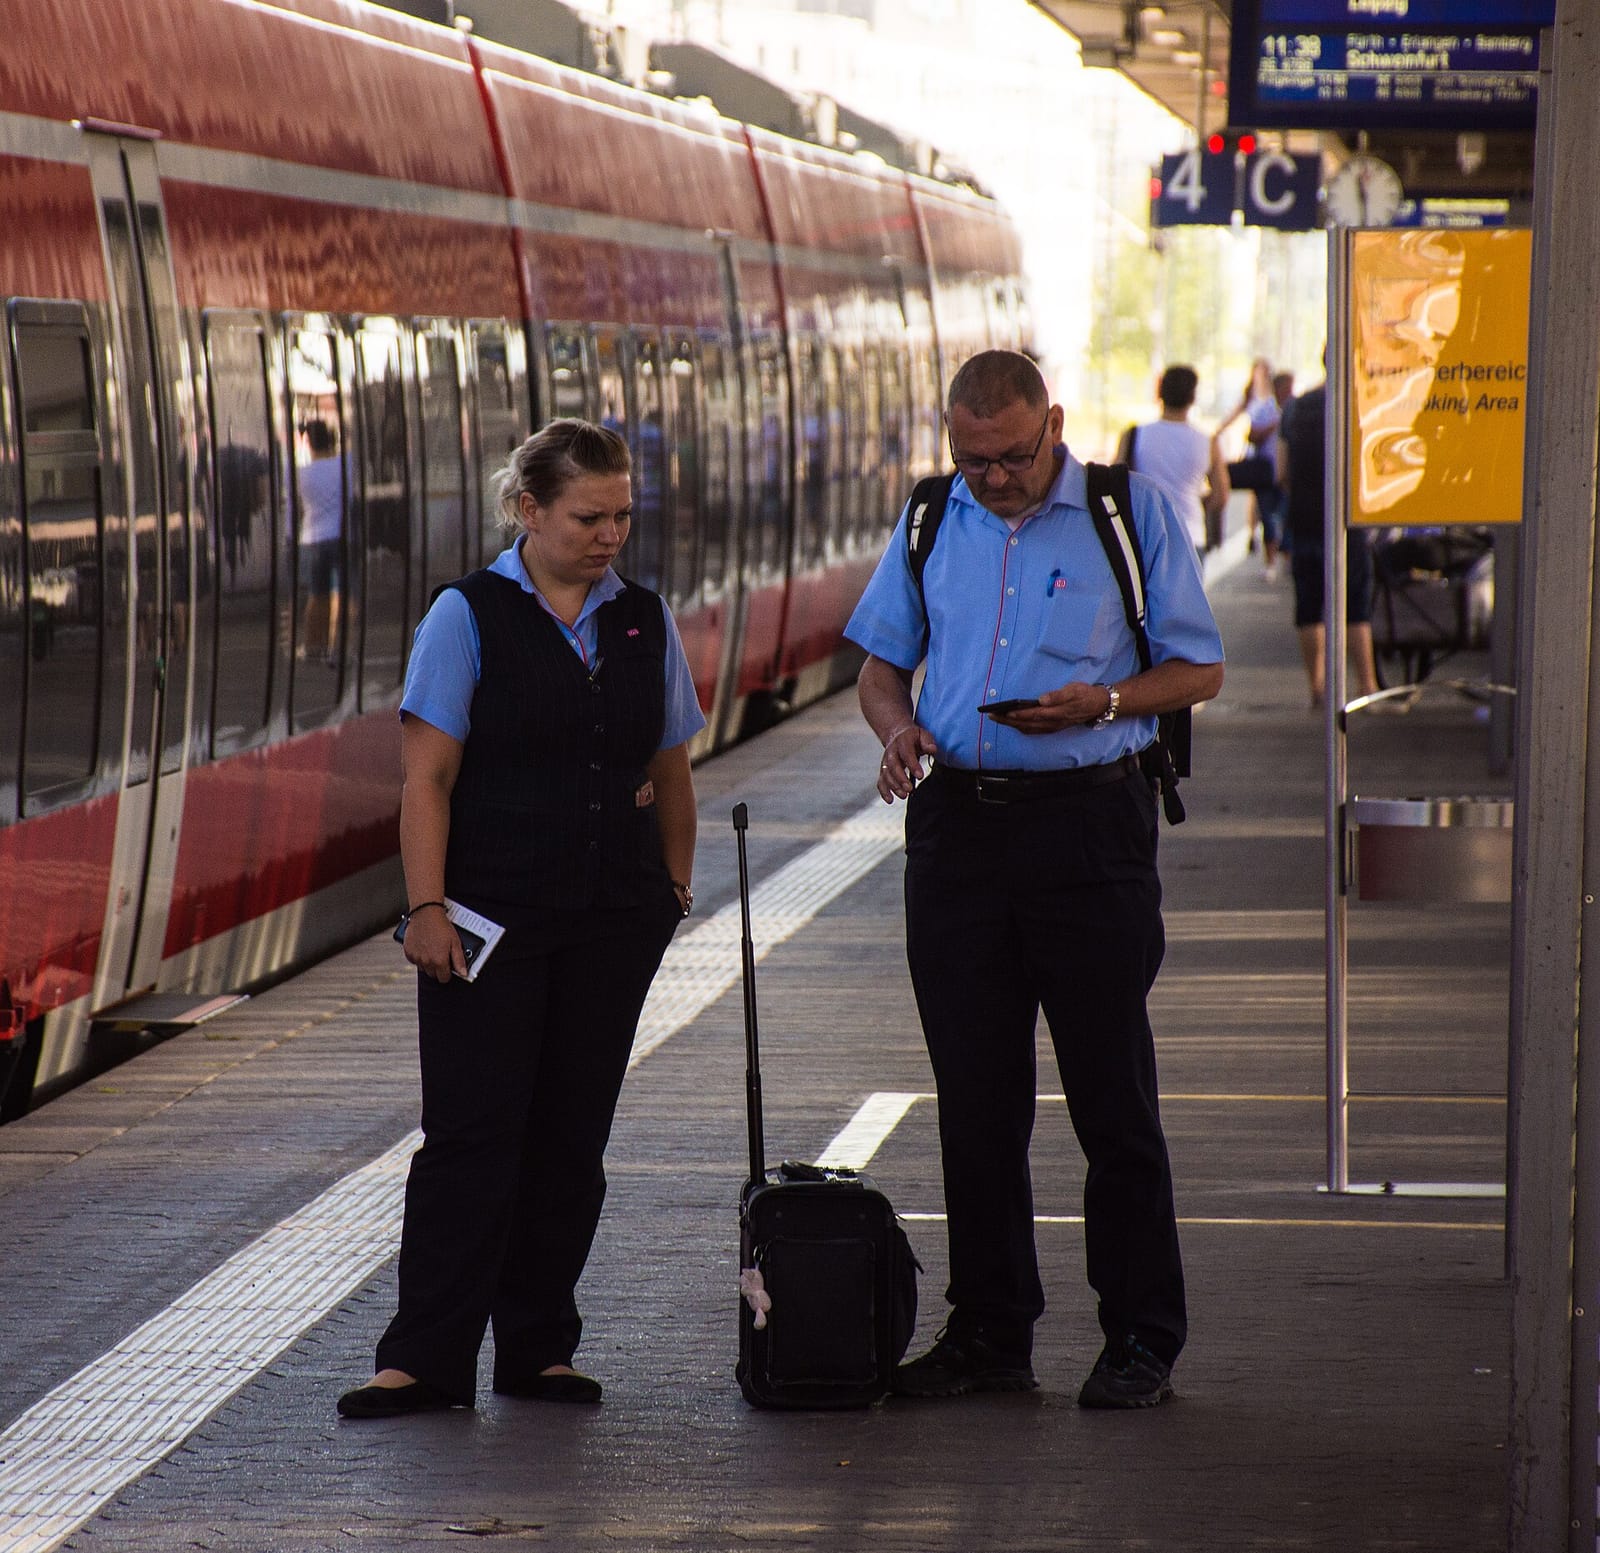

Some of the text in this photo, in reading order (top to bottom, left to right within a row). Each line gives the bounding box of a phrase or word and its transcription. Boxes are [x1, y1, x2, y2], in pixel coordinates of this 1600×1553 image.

[1166, 151, 1207, 212] 4
[1251, 153, 1297, 214] C
[1475, 393, 1518, 411] Area
